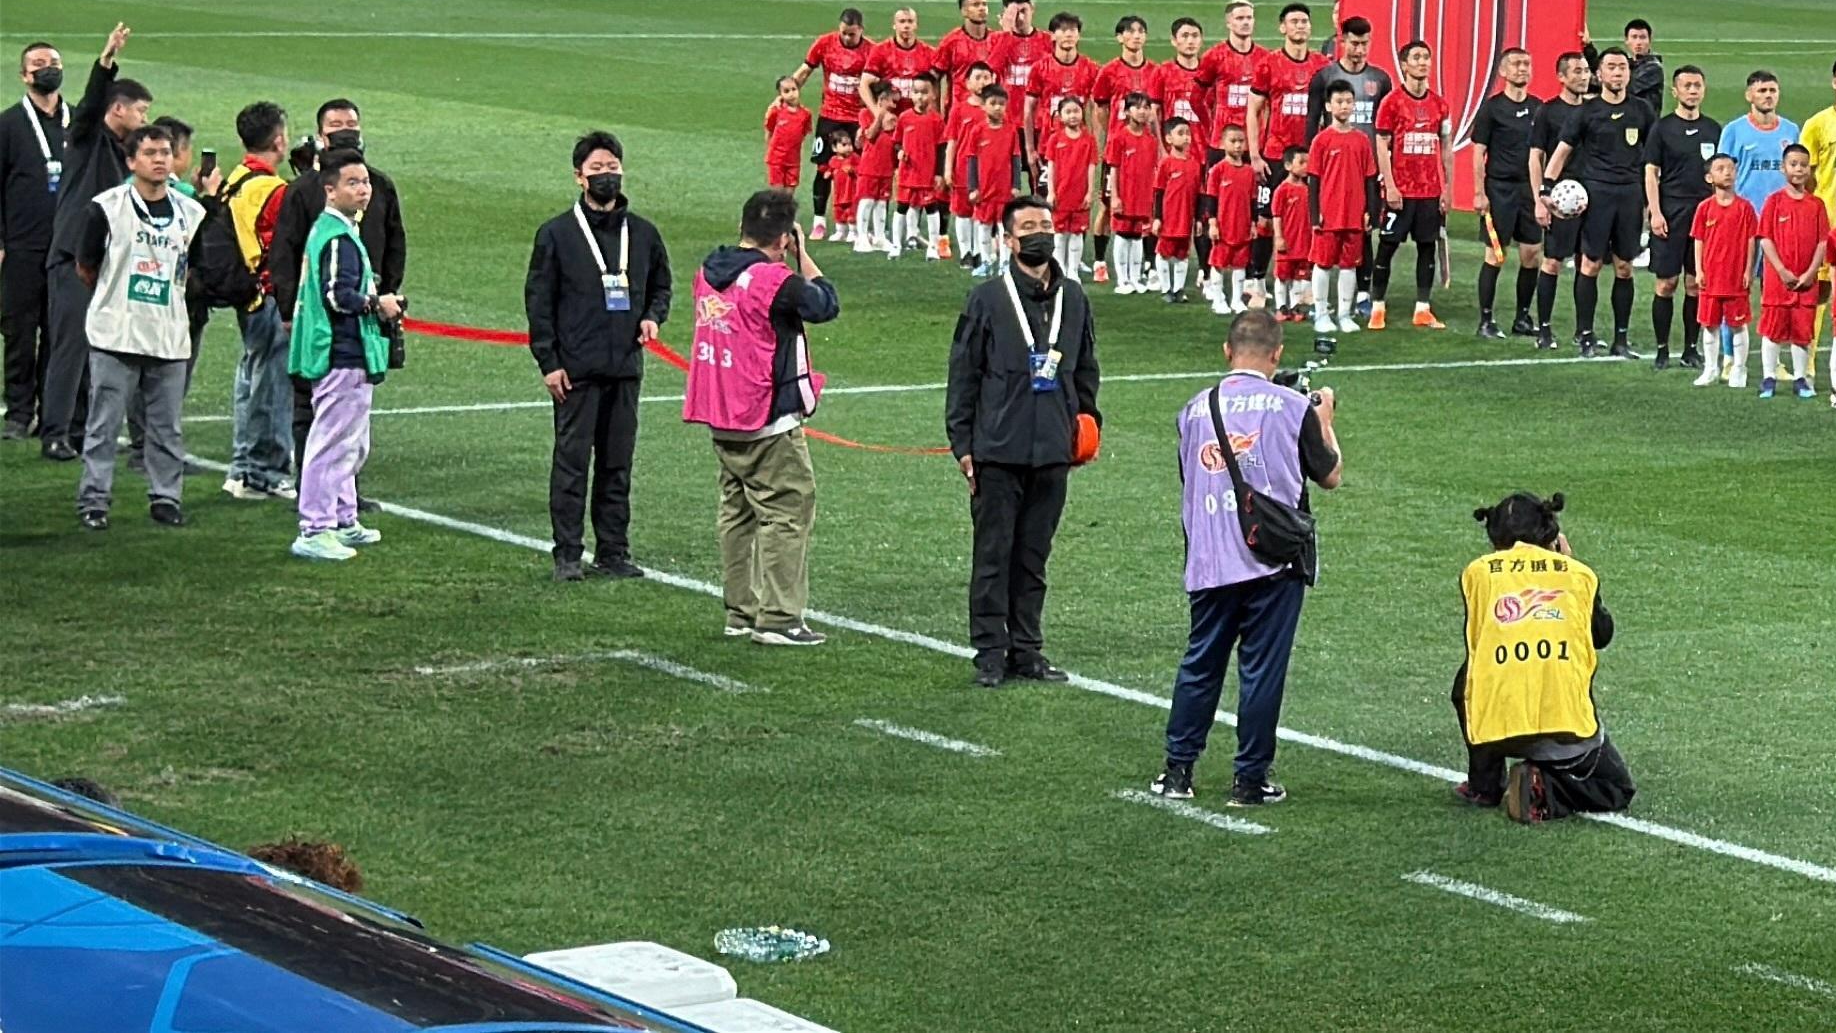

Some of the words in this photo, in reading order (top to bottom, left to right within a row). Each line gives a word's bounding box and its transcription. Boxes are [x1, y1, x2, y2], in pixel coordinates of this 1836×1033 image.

[1258, 185, 1270, 205] 18
[1386, 212, 1397, 231] 7
[1495, 638, 1570, 665] 0001
